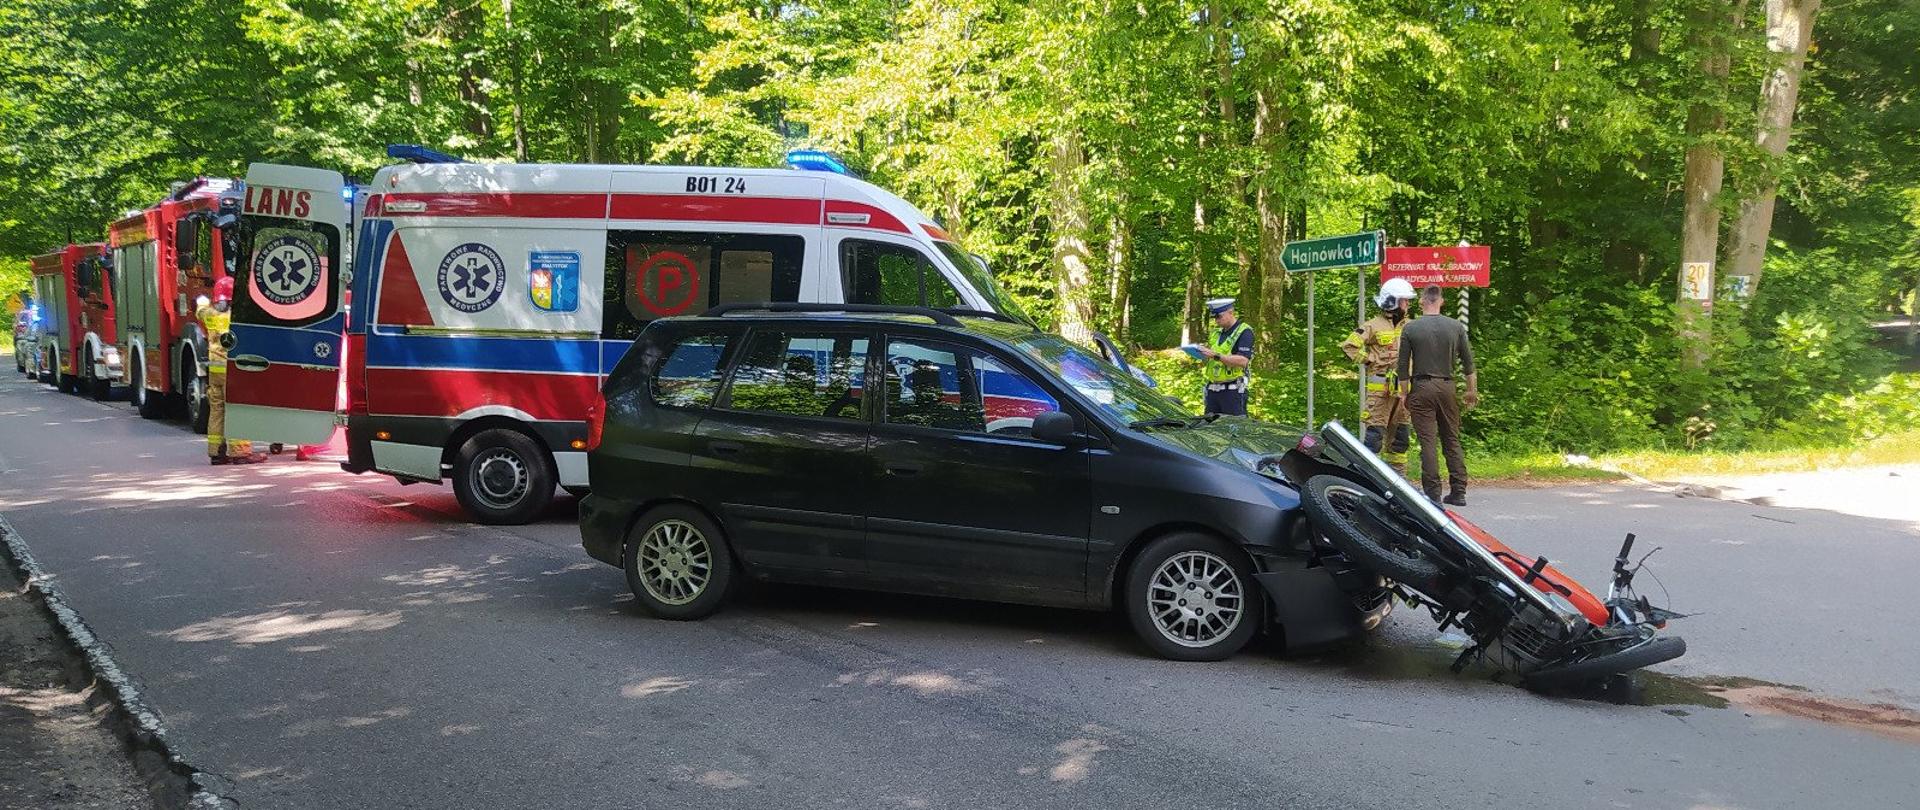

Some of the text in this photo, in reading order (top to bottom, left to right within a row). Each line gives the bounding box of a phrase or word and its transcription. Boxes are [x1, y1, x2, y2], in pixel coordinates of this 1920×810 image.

[724, 177, 746, 193] 24
[244, 186, 311, 217] LANS
[295, 240, 320, 286] RATOWNICTWO
[1291, 240, 1371, 266] Hajnówka 10
[478, 246, 504, 292] RATOWNICTWO
[1387, 263, 1425, 271] REZERWAT
[1687, 265, 1705, 280] 20
[657, 265, 683, 304] P
[264, 290, 307, 303] MEDYCZNE
[449, 298, 493, 311] MEDYCZNE
